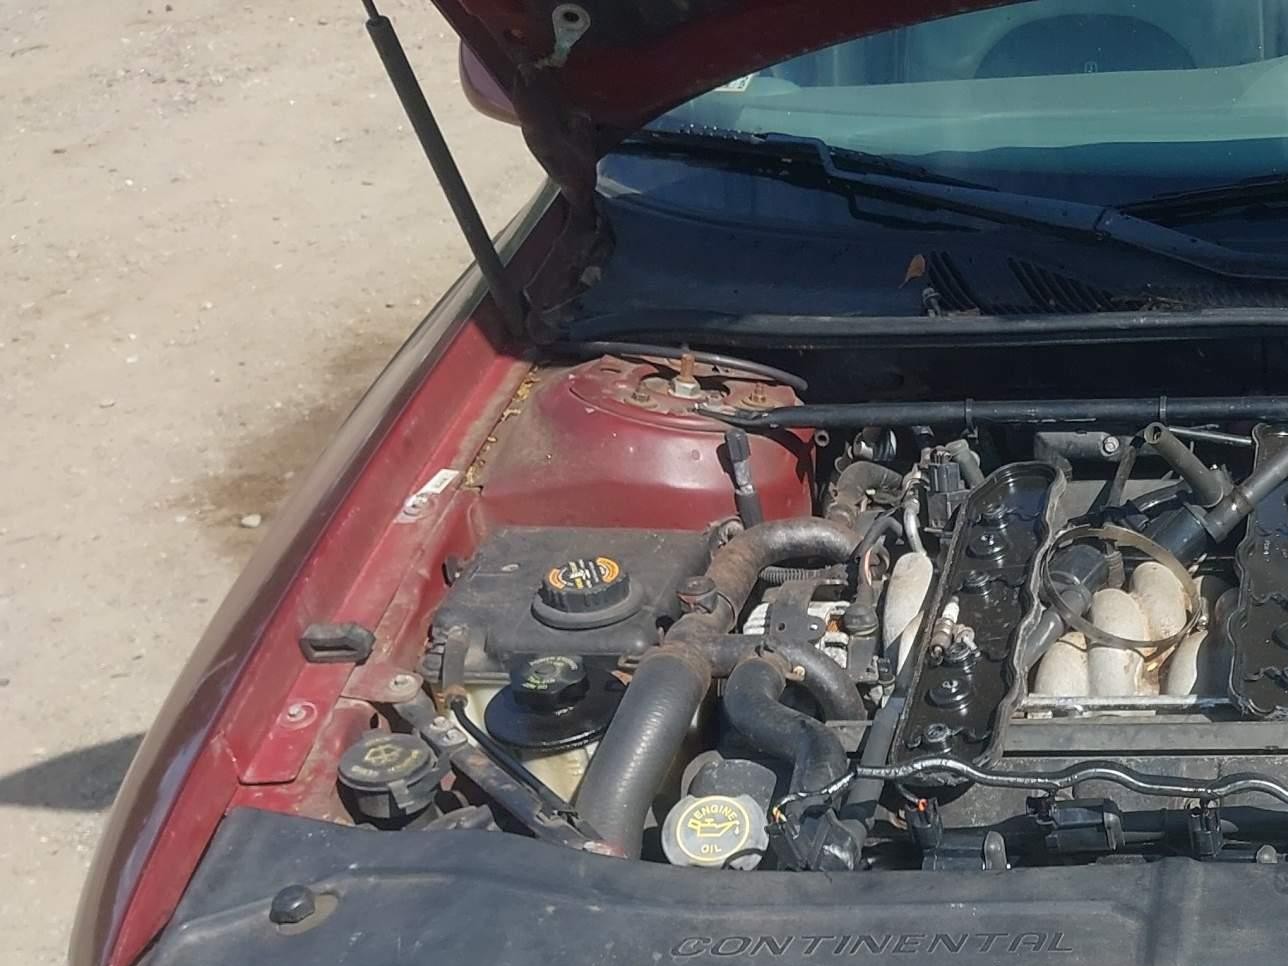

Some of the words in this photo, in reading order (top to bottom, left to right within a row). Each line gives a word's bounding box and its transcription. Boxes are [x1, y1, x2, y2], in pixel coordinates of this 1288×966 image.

[693, 803, 738, 822] ENGINE
[701, 843, 723, 854] OIL
[670, 931, 1074, 958] CONTINENTAL
